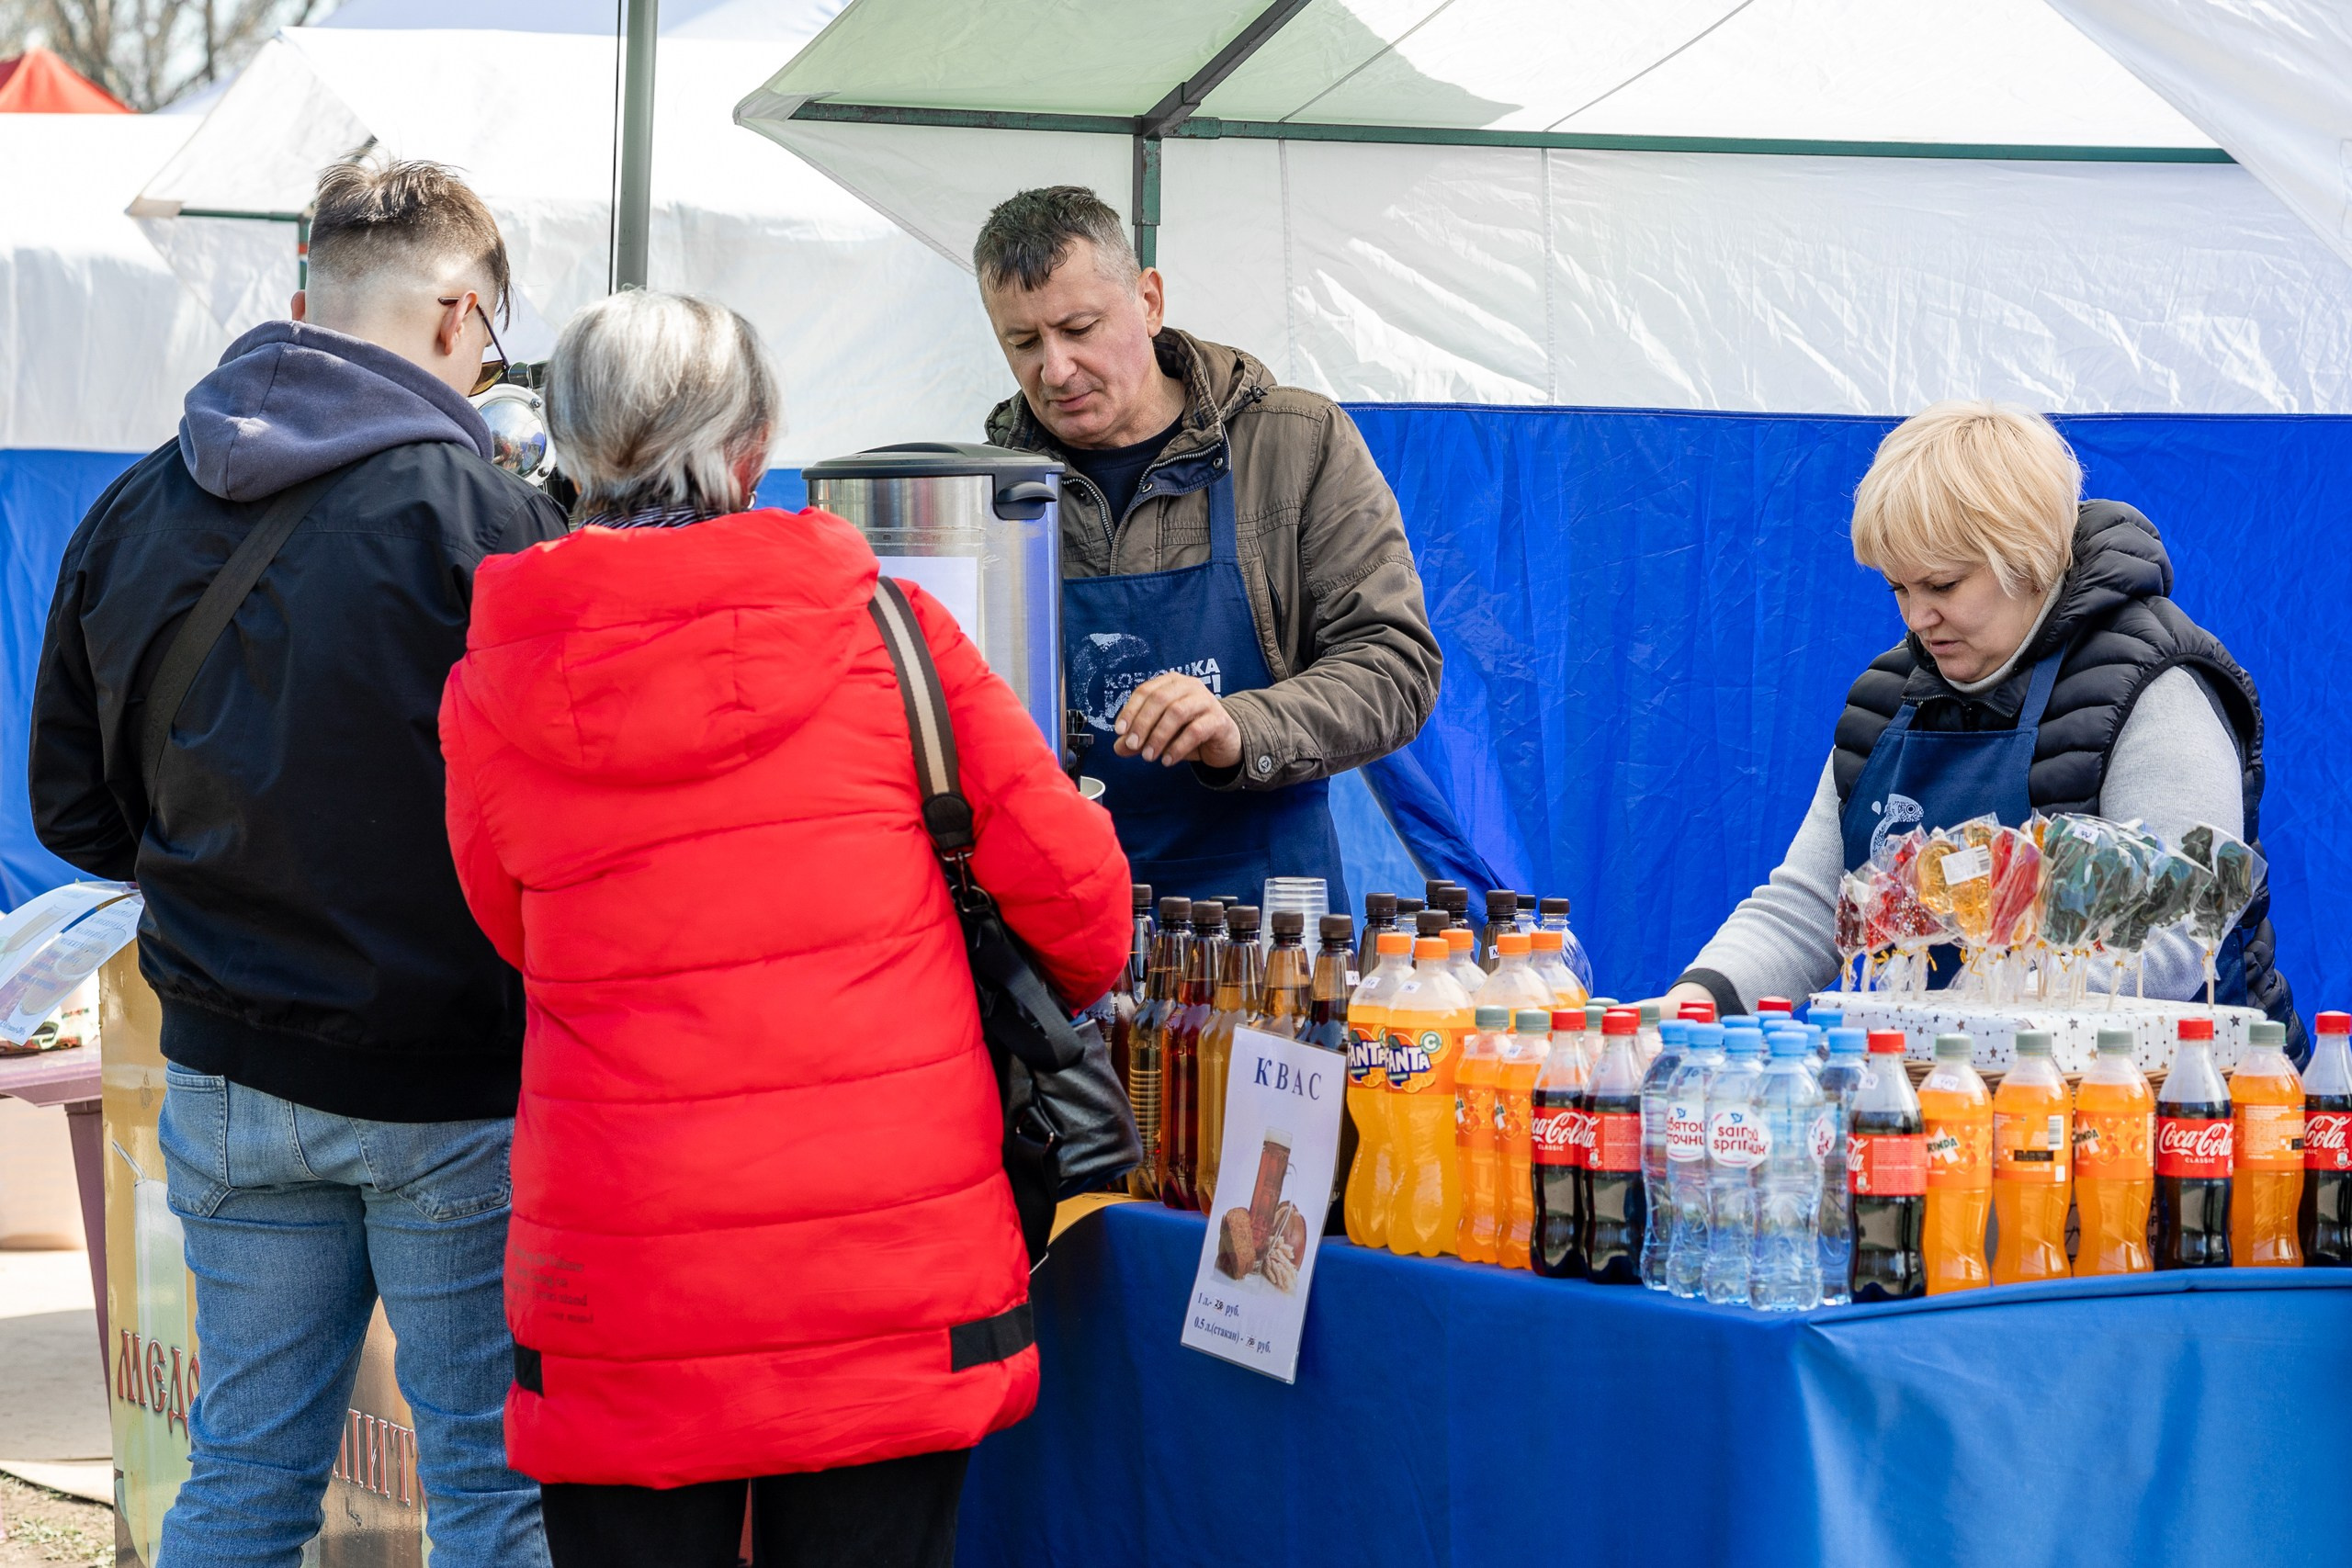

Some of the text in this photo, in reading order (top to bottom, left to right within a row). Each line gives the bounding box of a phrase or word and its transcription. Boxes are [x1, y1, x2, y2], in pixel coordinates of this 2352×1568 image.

[1253, 1056, 1322, 1100] КВАС
[1538, 1144, 1565, 1152] CLASSIC
[2159, 1121, 2234, 1157] Coca-Cola
